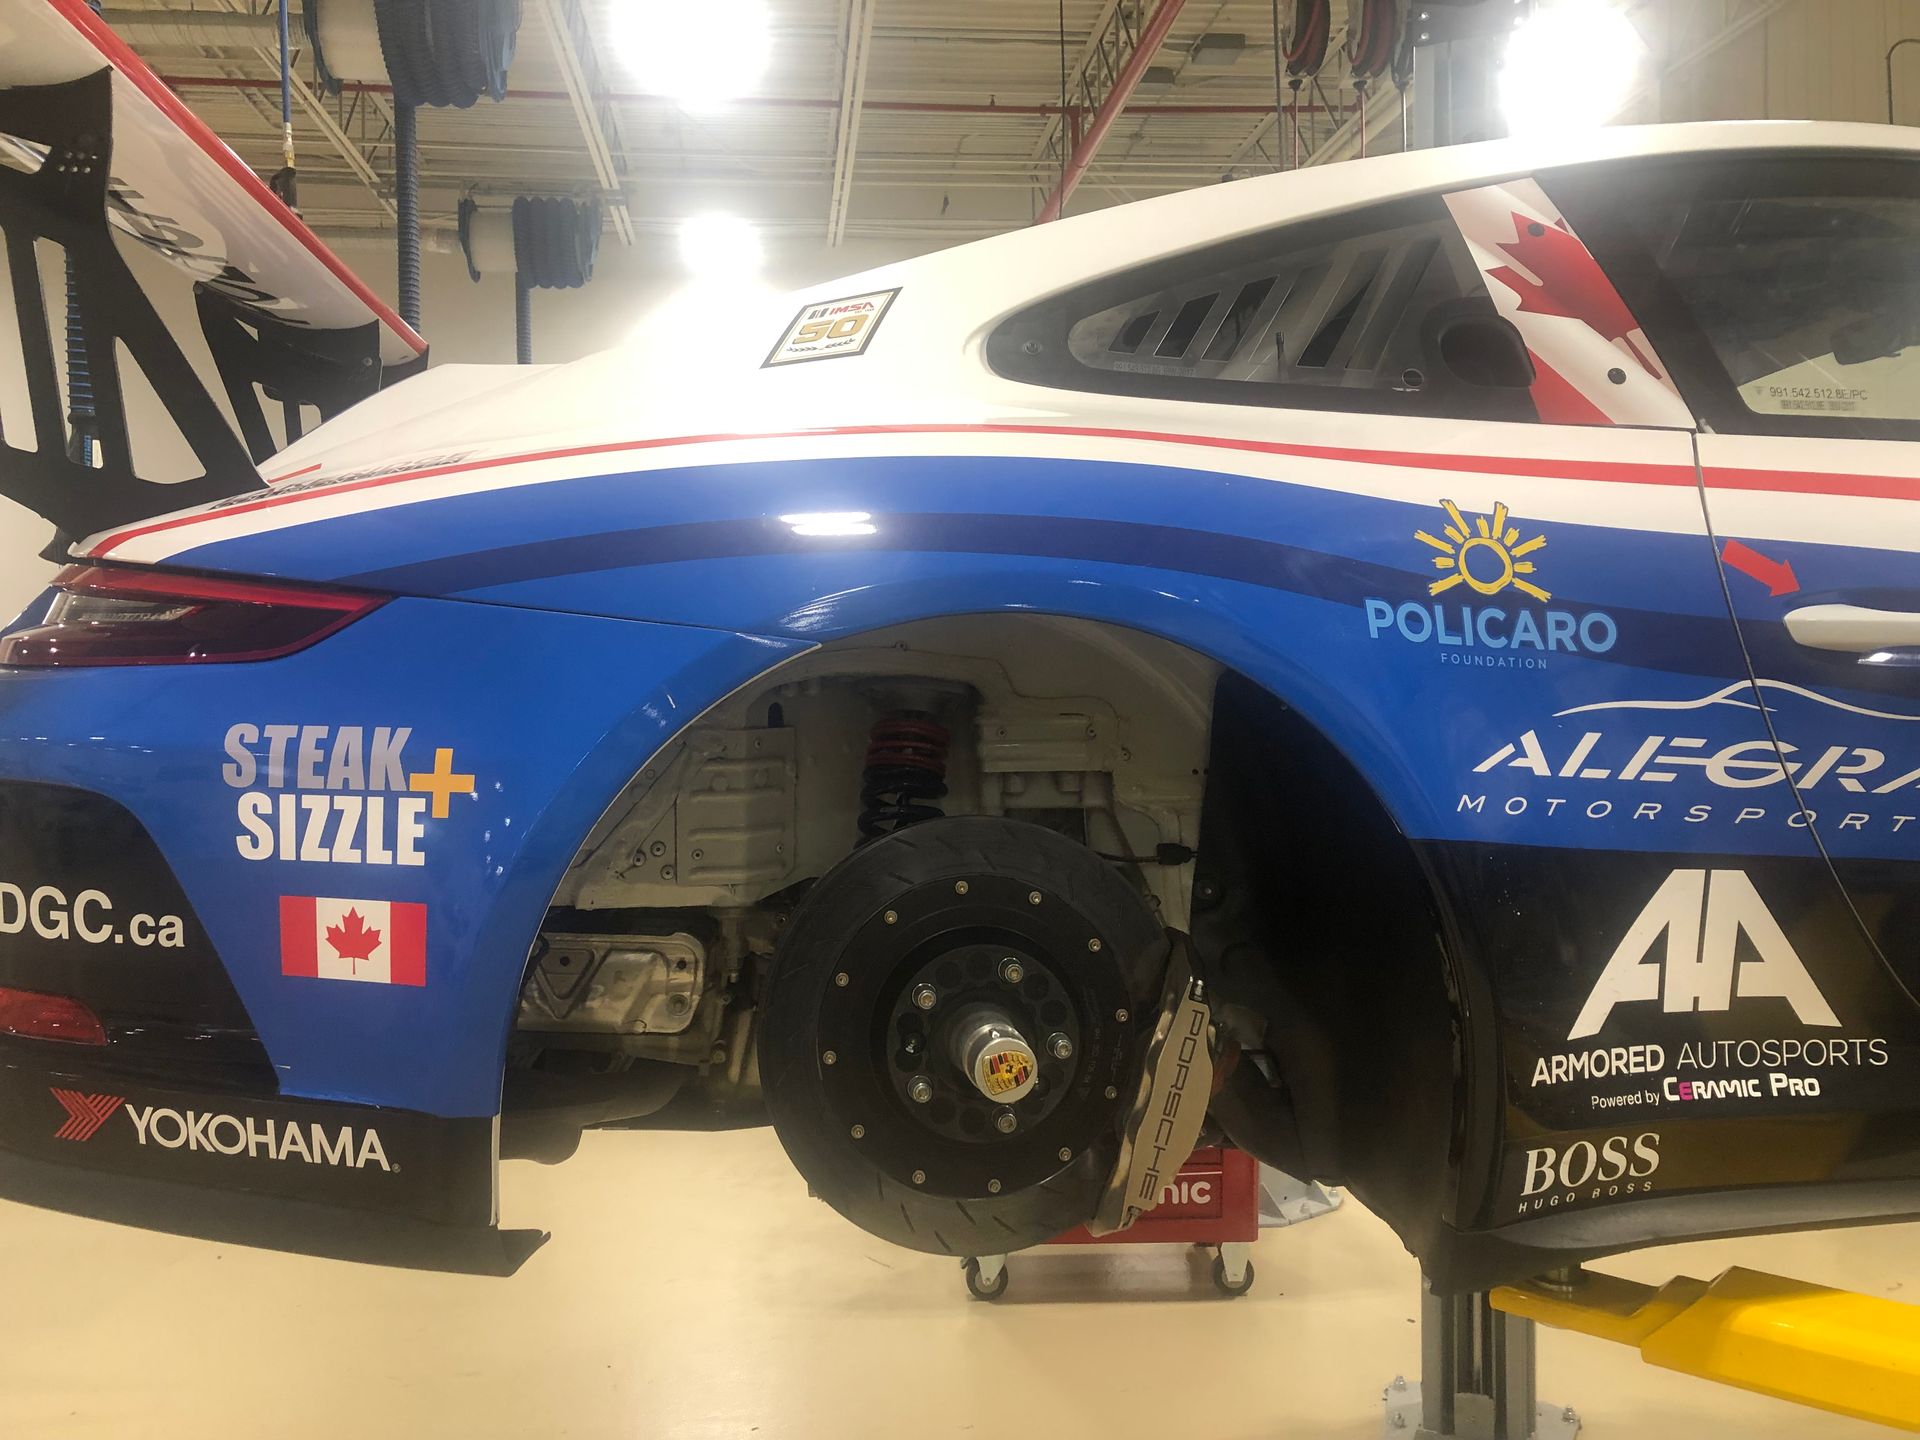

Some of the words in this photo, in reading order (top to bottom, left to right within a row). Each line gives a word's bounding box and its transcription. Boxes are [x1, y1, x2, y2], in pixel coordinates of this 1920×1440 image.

[792, 314, 869, 345] 50
[829, 301, 875, 315] IMSA
[1365, 599, 1617, 653] POLICARO
[1440, 652, 1547, 669] FOUNDATION
[222, 723, 412, 791] STEAK
[236, 792, 426, 866] SIZZLE
[1457, 794, 1917, 832] MOTORSPORT
[1531, 1044, 1665, 1087] ARMORED
[1676, 1039, 1889, 1070] AUTOSPORTS
[1138, 1009, 1205, 1200] PORSCHE
[1591, 1091, 1643, 1110] Powered
[1645, 1090, 1661, 1105] by
[125, 1104, 391, 1172] YOKOHAMA
[1520, 1132, 1660, 1197] BOSS
[1157, 1181, 1211, 1204] nic
[1518, 1192, 1576, 1213] HUGO
